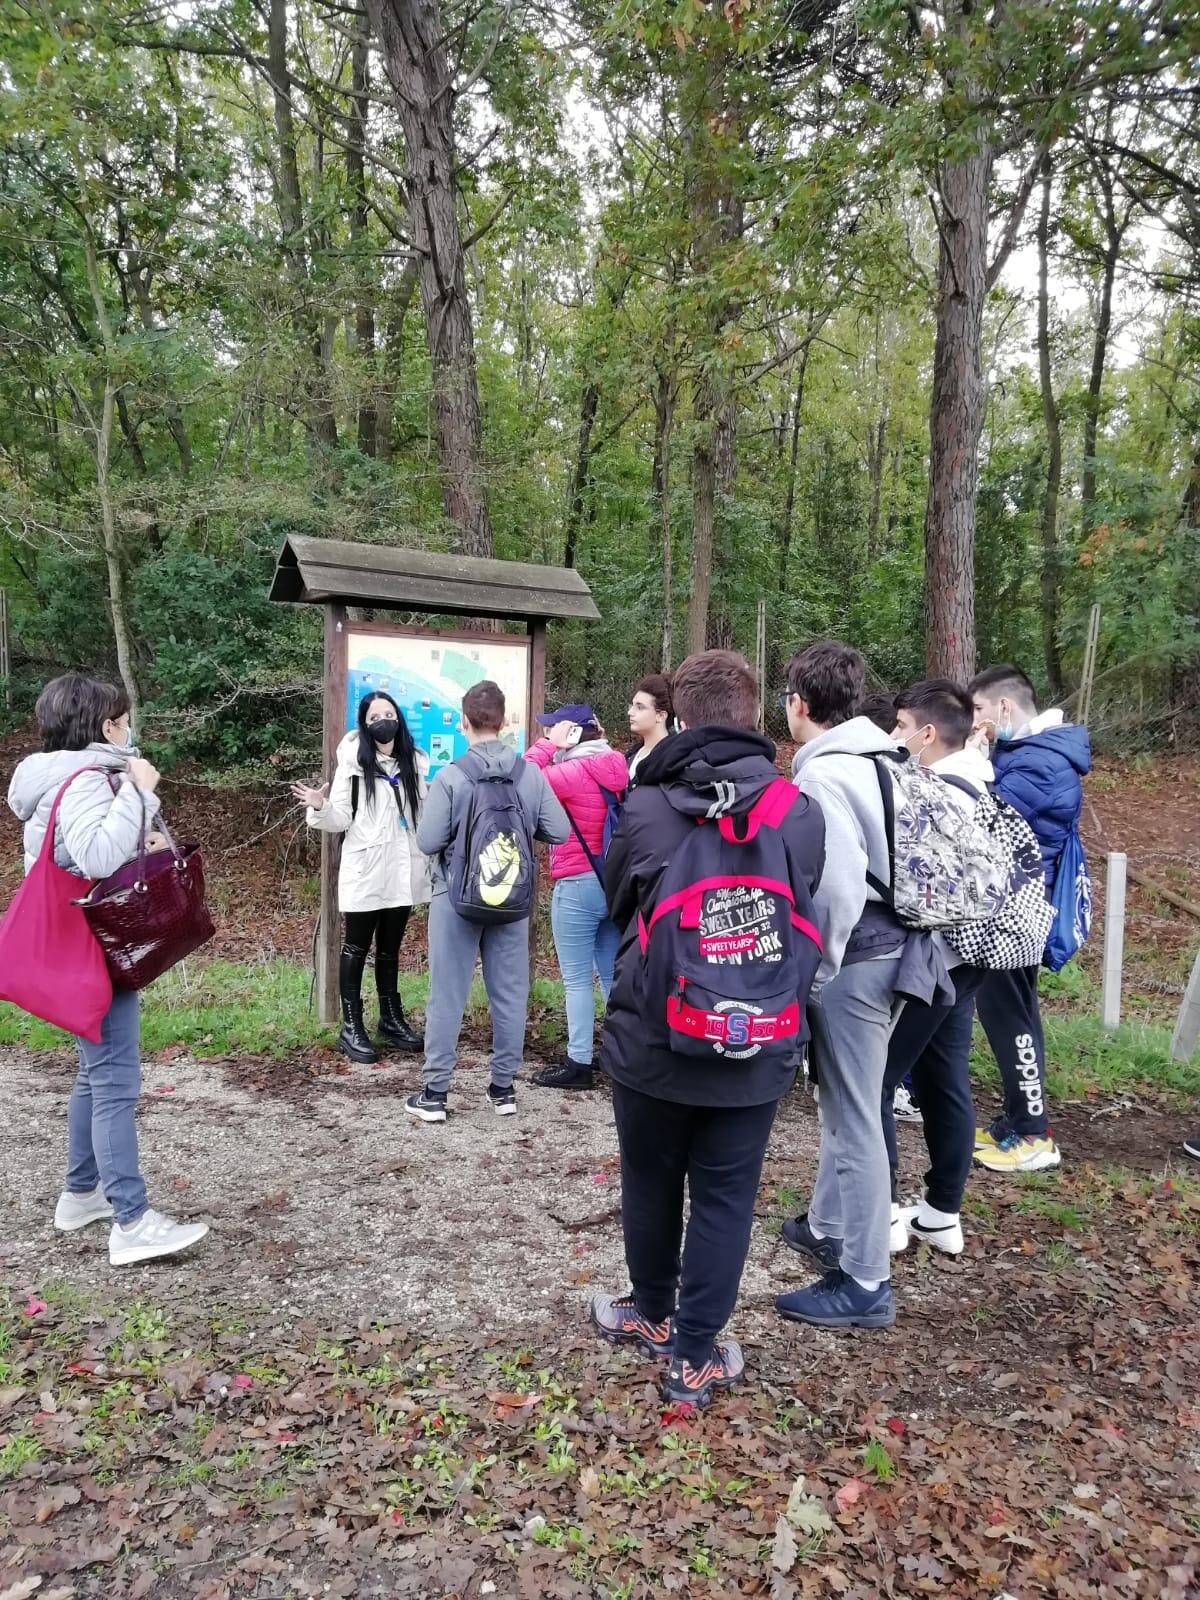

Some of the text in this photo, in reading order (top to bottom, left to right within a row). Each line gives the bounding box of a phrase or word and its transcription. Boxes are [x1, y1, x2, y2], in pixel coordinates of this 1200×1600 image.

[698, 911, 734, 936] SWEET
[736, 898, 776, 924] YEARS
[726, 1013, 750, 1045] S
[1015, 1034, 1044, 1116] adidas
